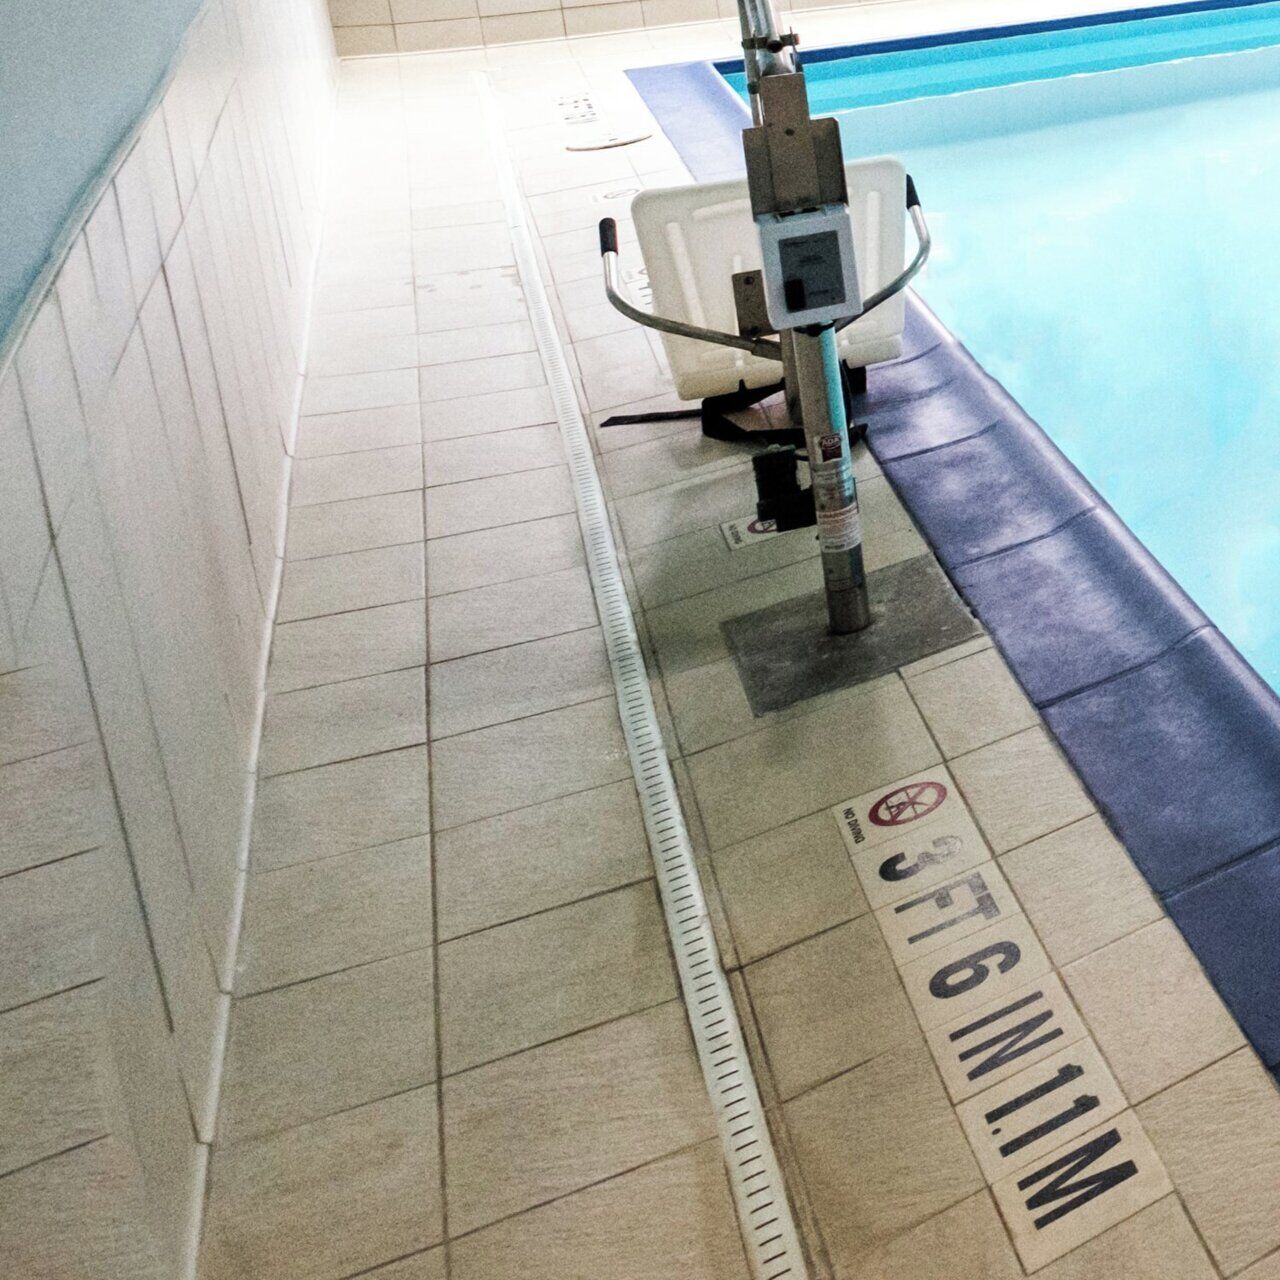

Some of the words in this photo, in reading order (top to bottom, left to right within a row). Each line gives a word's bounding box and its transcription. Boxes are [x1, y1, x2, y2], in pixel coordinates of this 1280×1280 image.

[842, 807, 856, 820] NO
[878, 834, 964, 883] 3
[893, 871, 1001, 945] FT
[928, 940, 1022, 1000] 6
[949, 990, 1064, 1082] IN
